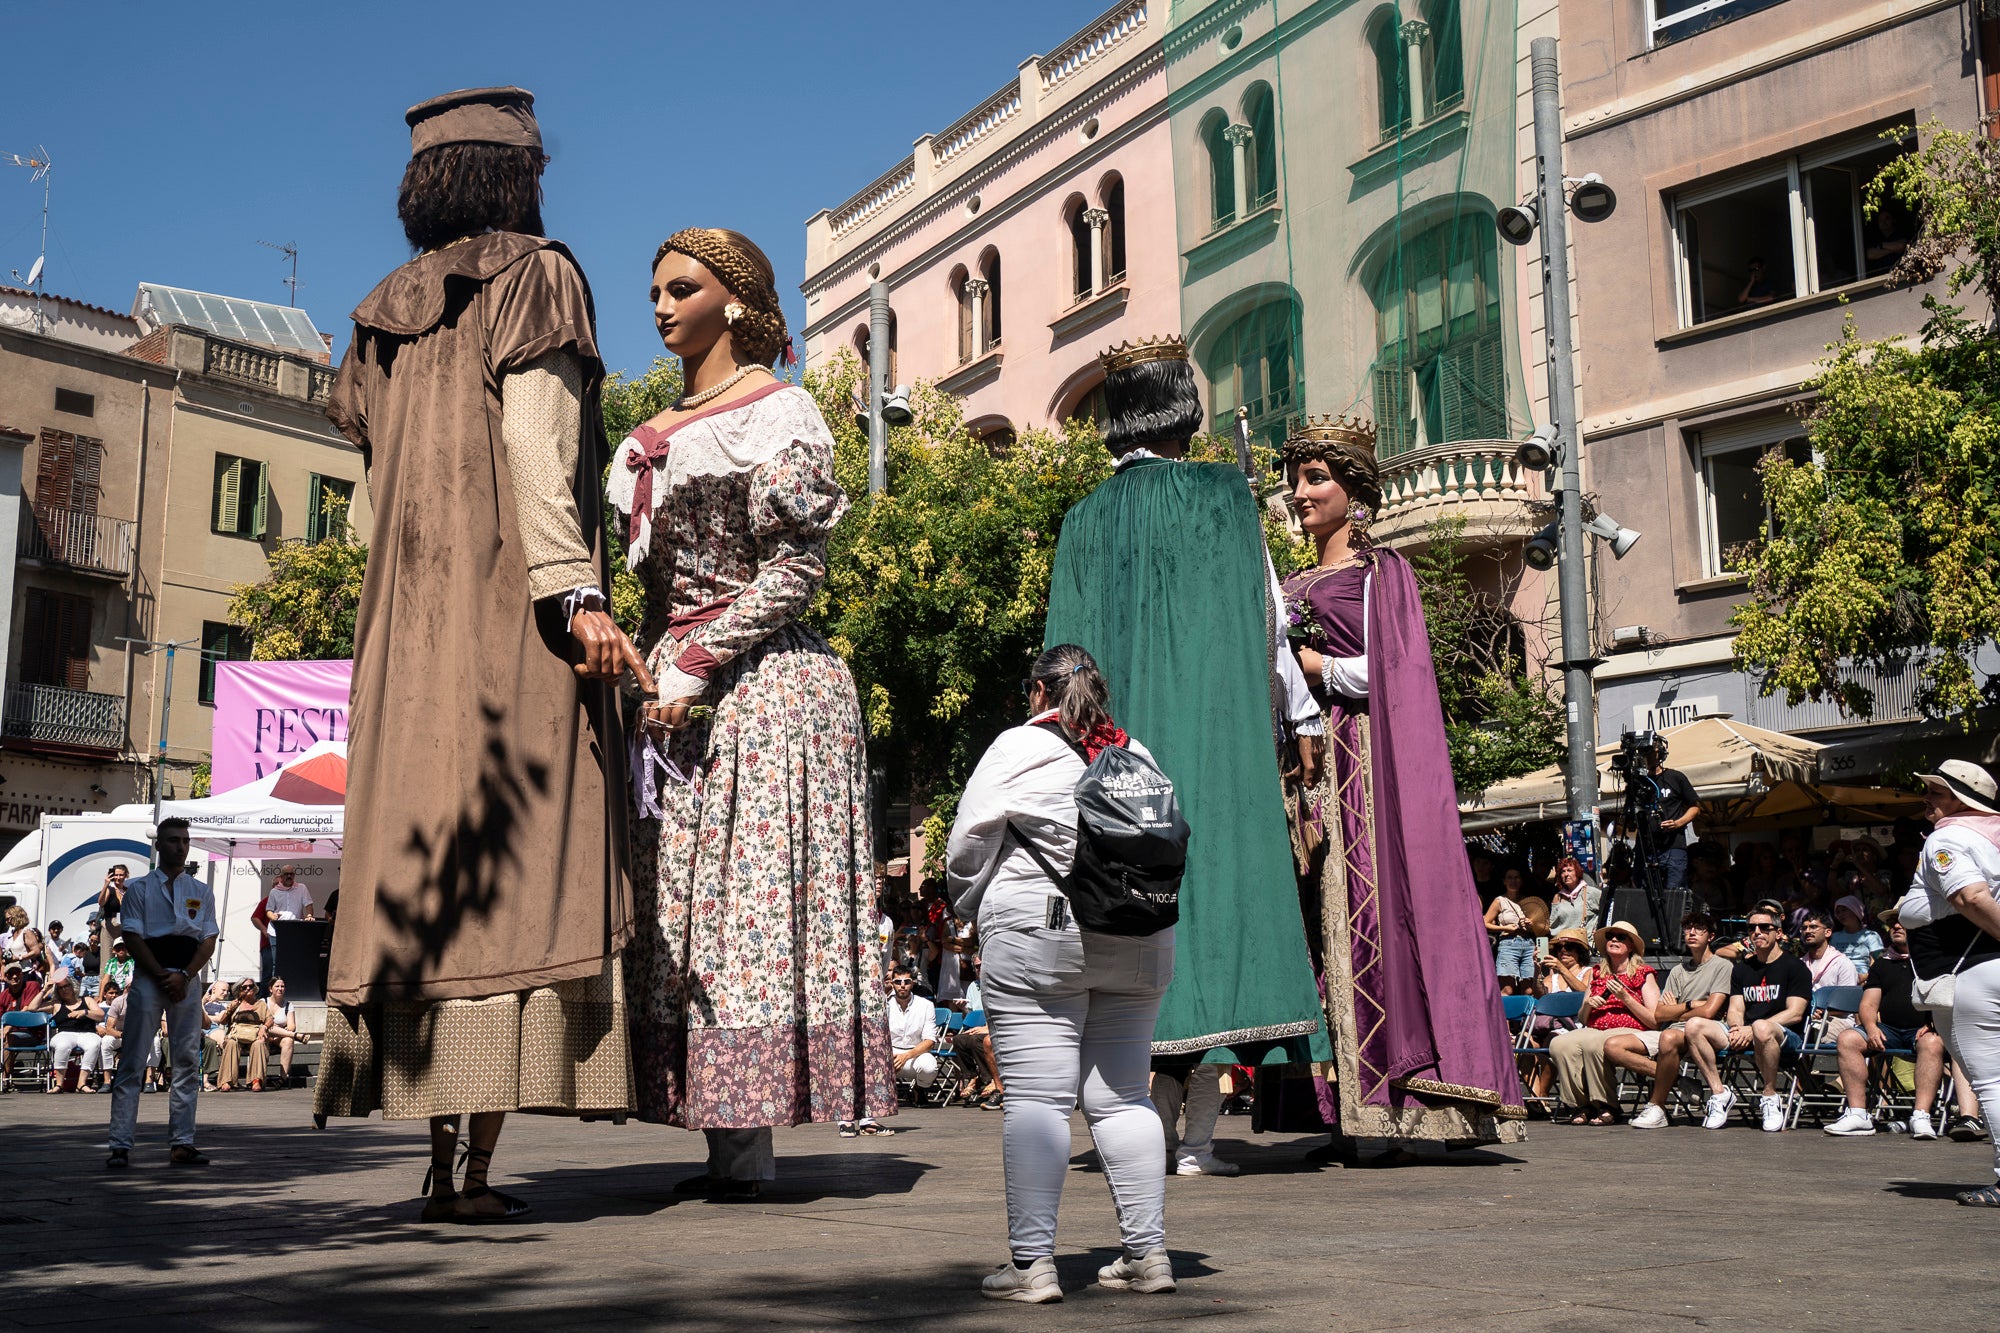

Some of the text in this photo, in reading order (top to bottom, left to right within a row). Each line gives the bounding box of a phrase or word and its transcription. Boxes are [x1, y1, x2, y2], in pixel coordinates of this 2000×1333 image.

[1831, 755, 1856, 770] 365
[259, 815, 334, 827] radiomunicipal
[294, 864, 324, 876] àdio
